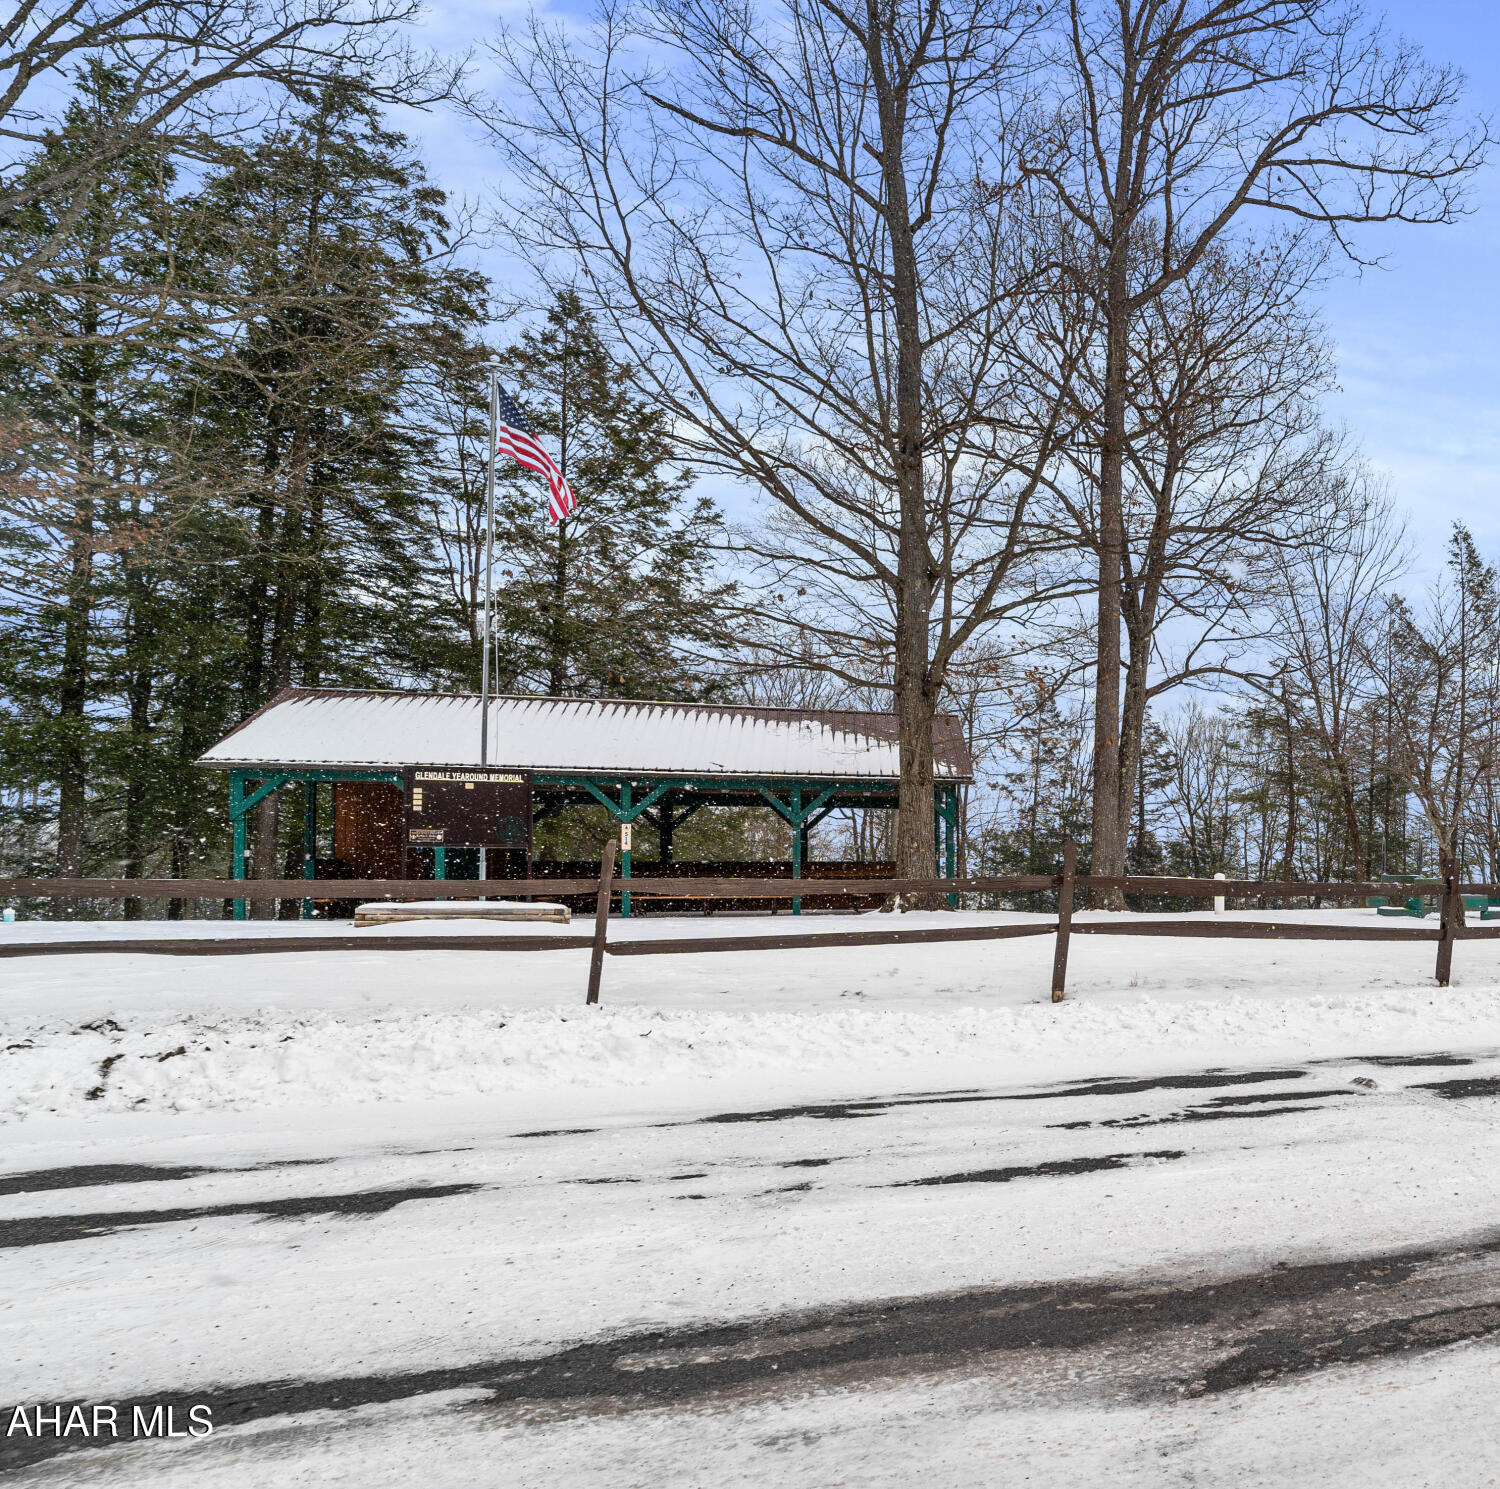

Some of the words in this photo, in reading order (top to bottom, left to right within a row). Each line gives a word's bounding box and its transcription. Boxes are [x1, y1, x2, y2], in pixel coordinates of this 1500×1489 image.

[415, 771, 450, 780] GLENDALE
[452, 772, 488, 781] YEAROUND
[489, 773, 524, 782] MEMORIAL
